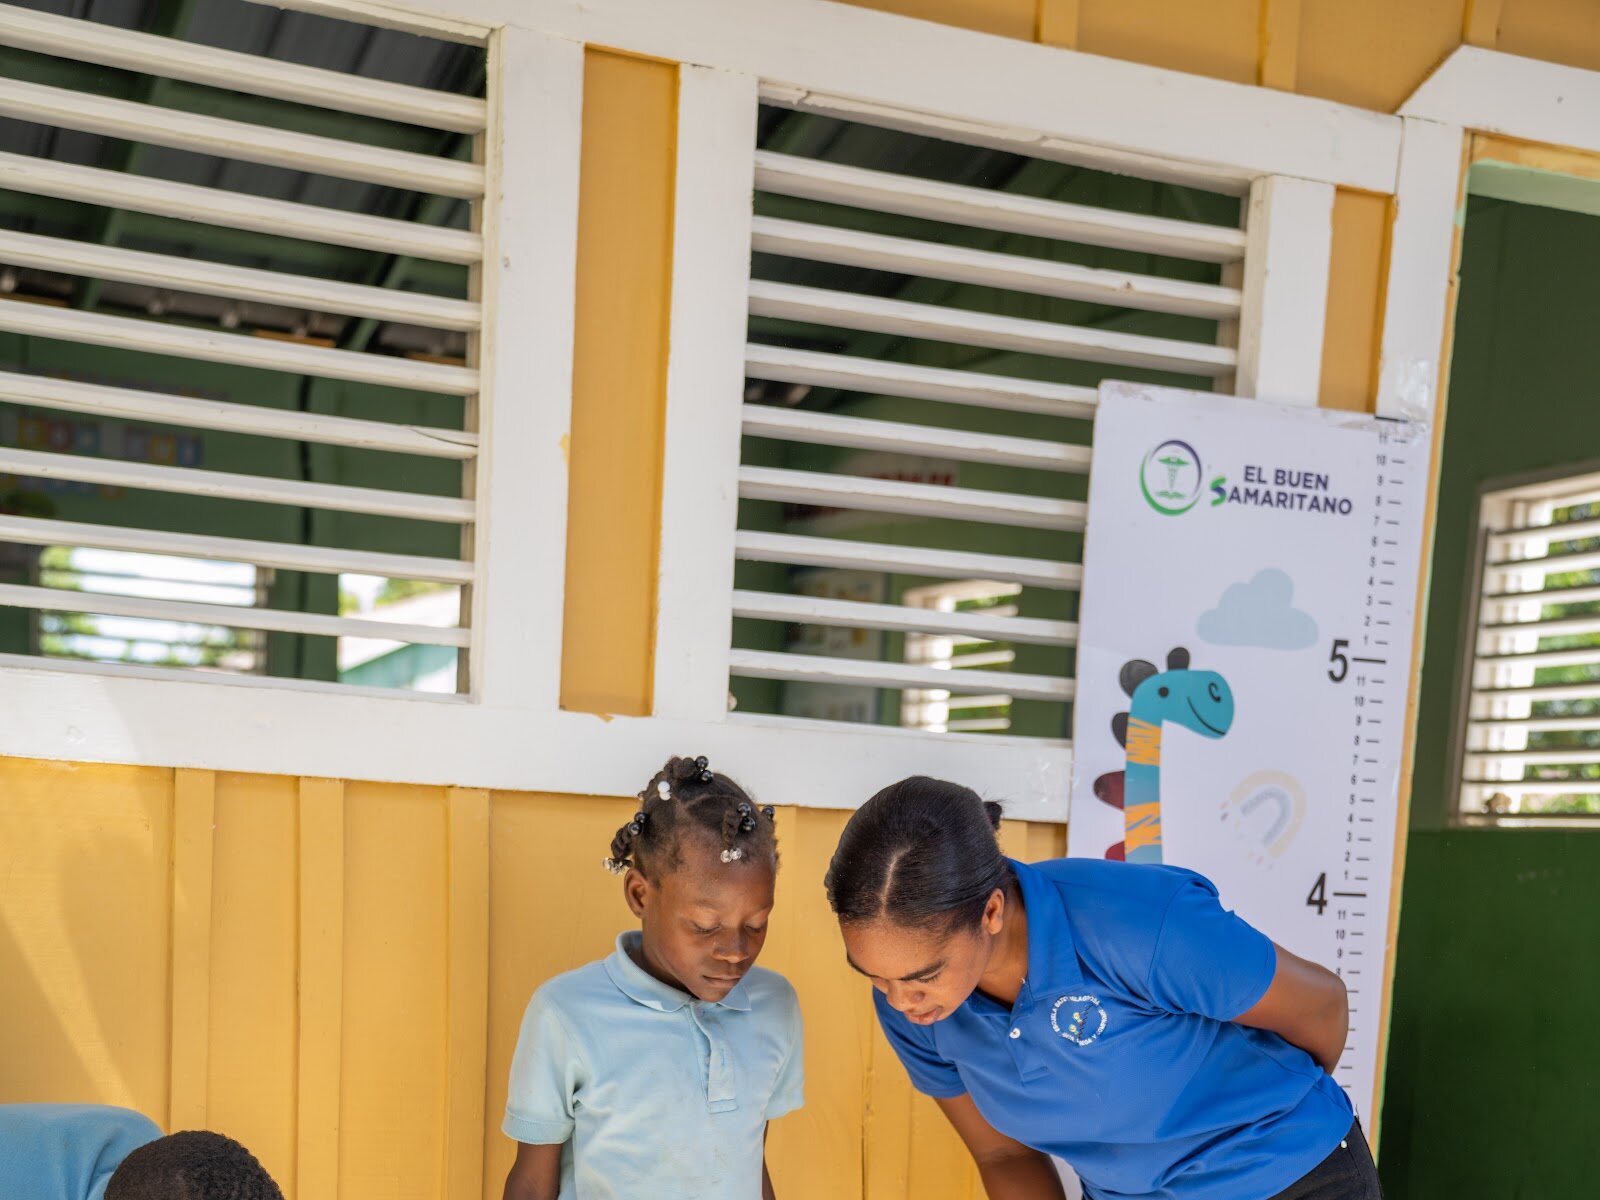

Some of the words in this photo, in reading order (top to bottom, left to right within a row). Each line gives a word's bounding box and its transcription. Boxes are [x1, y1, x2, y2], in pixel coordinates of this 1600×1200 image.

[1377, 432, 1390, 445] 11
[1375, 453, 1387, 467] 10
[1243, 465, 1267, 484] EL
[1274, 468, 1329, 491] BUEN
[1376, 474, 1384, 487] 9
[1210, 475, 1353, 515] SAMARITANO
[1375, 495, 1382, 507] 8
[1373, 514, 1381, 526] 7
[1371, 535, 1378, 548] 6
[1369, 555, 1377, 569] 5
[1367, 575, 1375, 587] 4
[1366, 594, 1373, 607] 3
[1363, 614, 1371, 627] 2
[1363, 634, 1369, 646] 1
[1327, 638, 1350, 684] 5
[1356, 675, 1367, 687] 11
[1354, 695, 1365, 707] 10
[1355, 715, 1362, 727] 9
[1353, 735, 1360, 746] 8
[1352, 753, 1359, 765] 7
[1350, 773, 1357, 786] 6
[1349, 793, 1356, 806] 5
[1347, 813, 1354, 824] 4
[1346, 831, 1353, 843] 3
[1344, 850, 1351, 863] 2
[1343, 869, 1349, 881] 1
[1305, 872, 1328, 916] 4
[1337, 909, 1347, 921] 11
[1335, 928, 1346, 941] 10
[1336, 947, 1344, 959] 9
